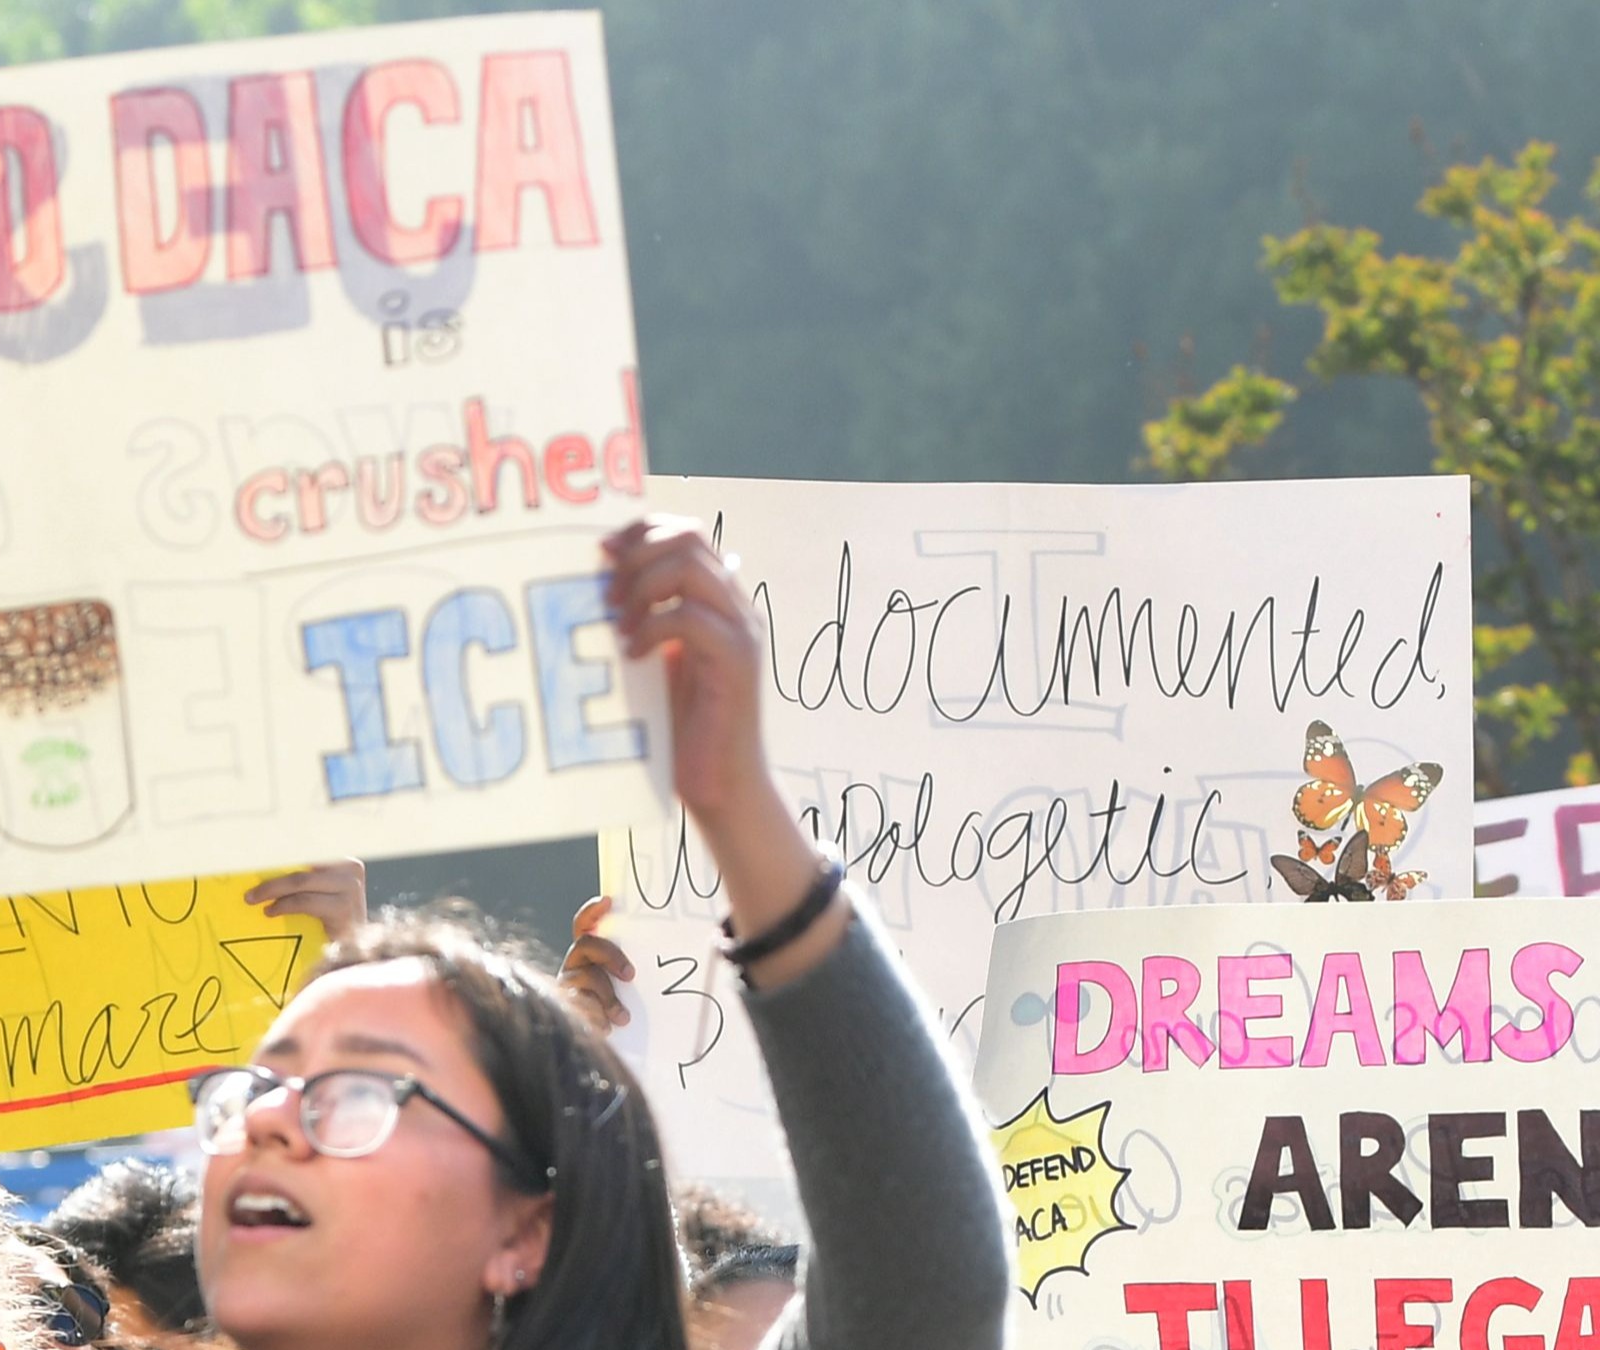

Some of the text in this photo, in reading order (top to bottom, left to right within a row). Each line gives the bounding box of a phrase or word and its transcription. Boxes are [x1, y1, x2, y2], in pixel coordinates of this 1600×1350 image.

[109, 48, 600, 296] DACA
[377, 288, 466, 368] is
[234, 366, 645, 540] crushed
[302, 570, 650, 803] ICE
[628, 765, 1274, 923] Upologetic,
[1051, 941, 1585, 1076] DREAMS
[1002, 1145, 1096, 1194] DEFEND
[1015, 1202, 1068, 1248] ACA
